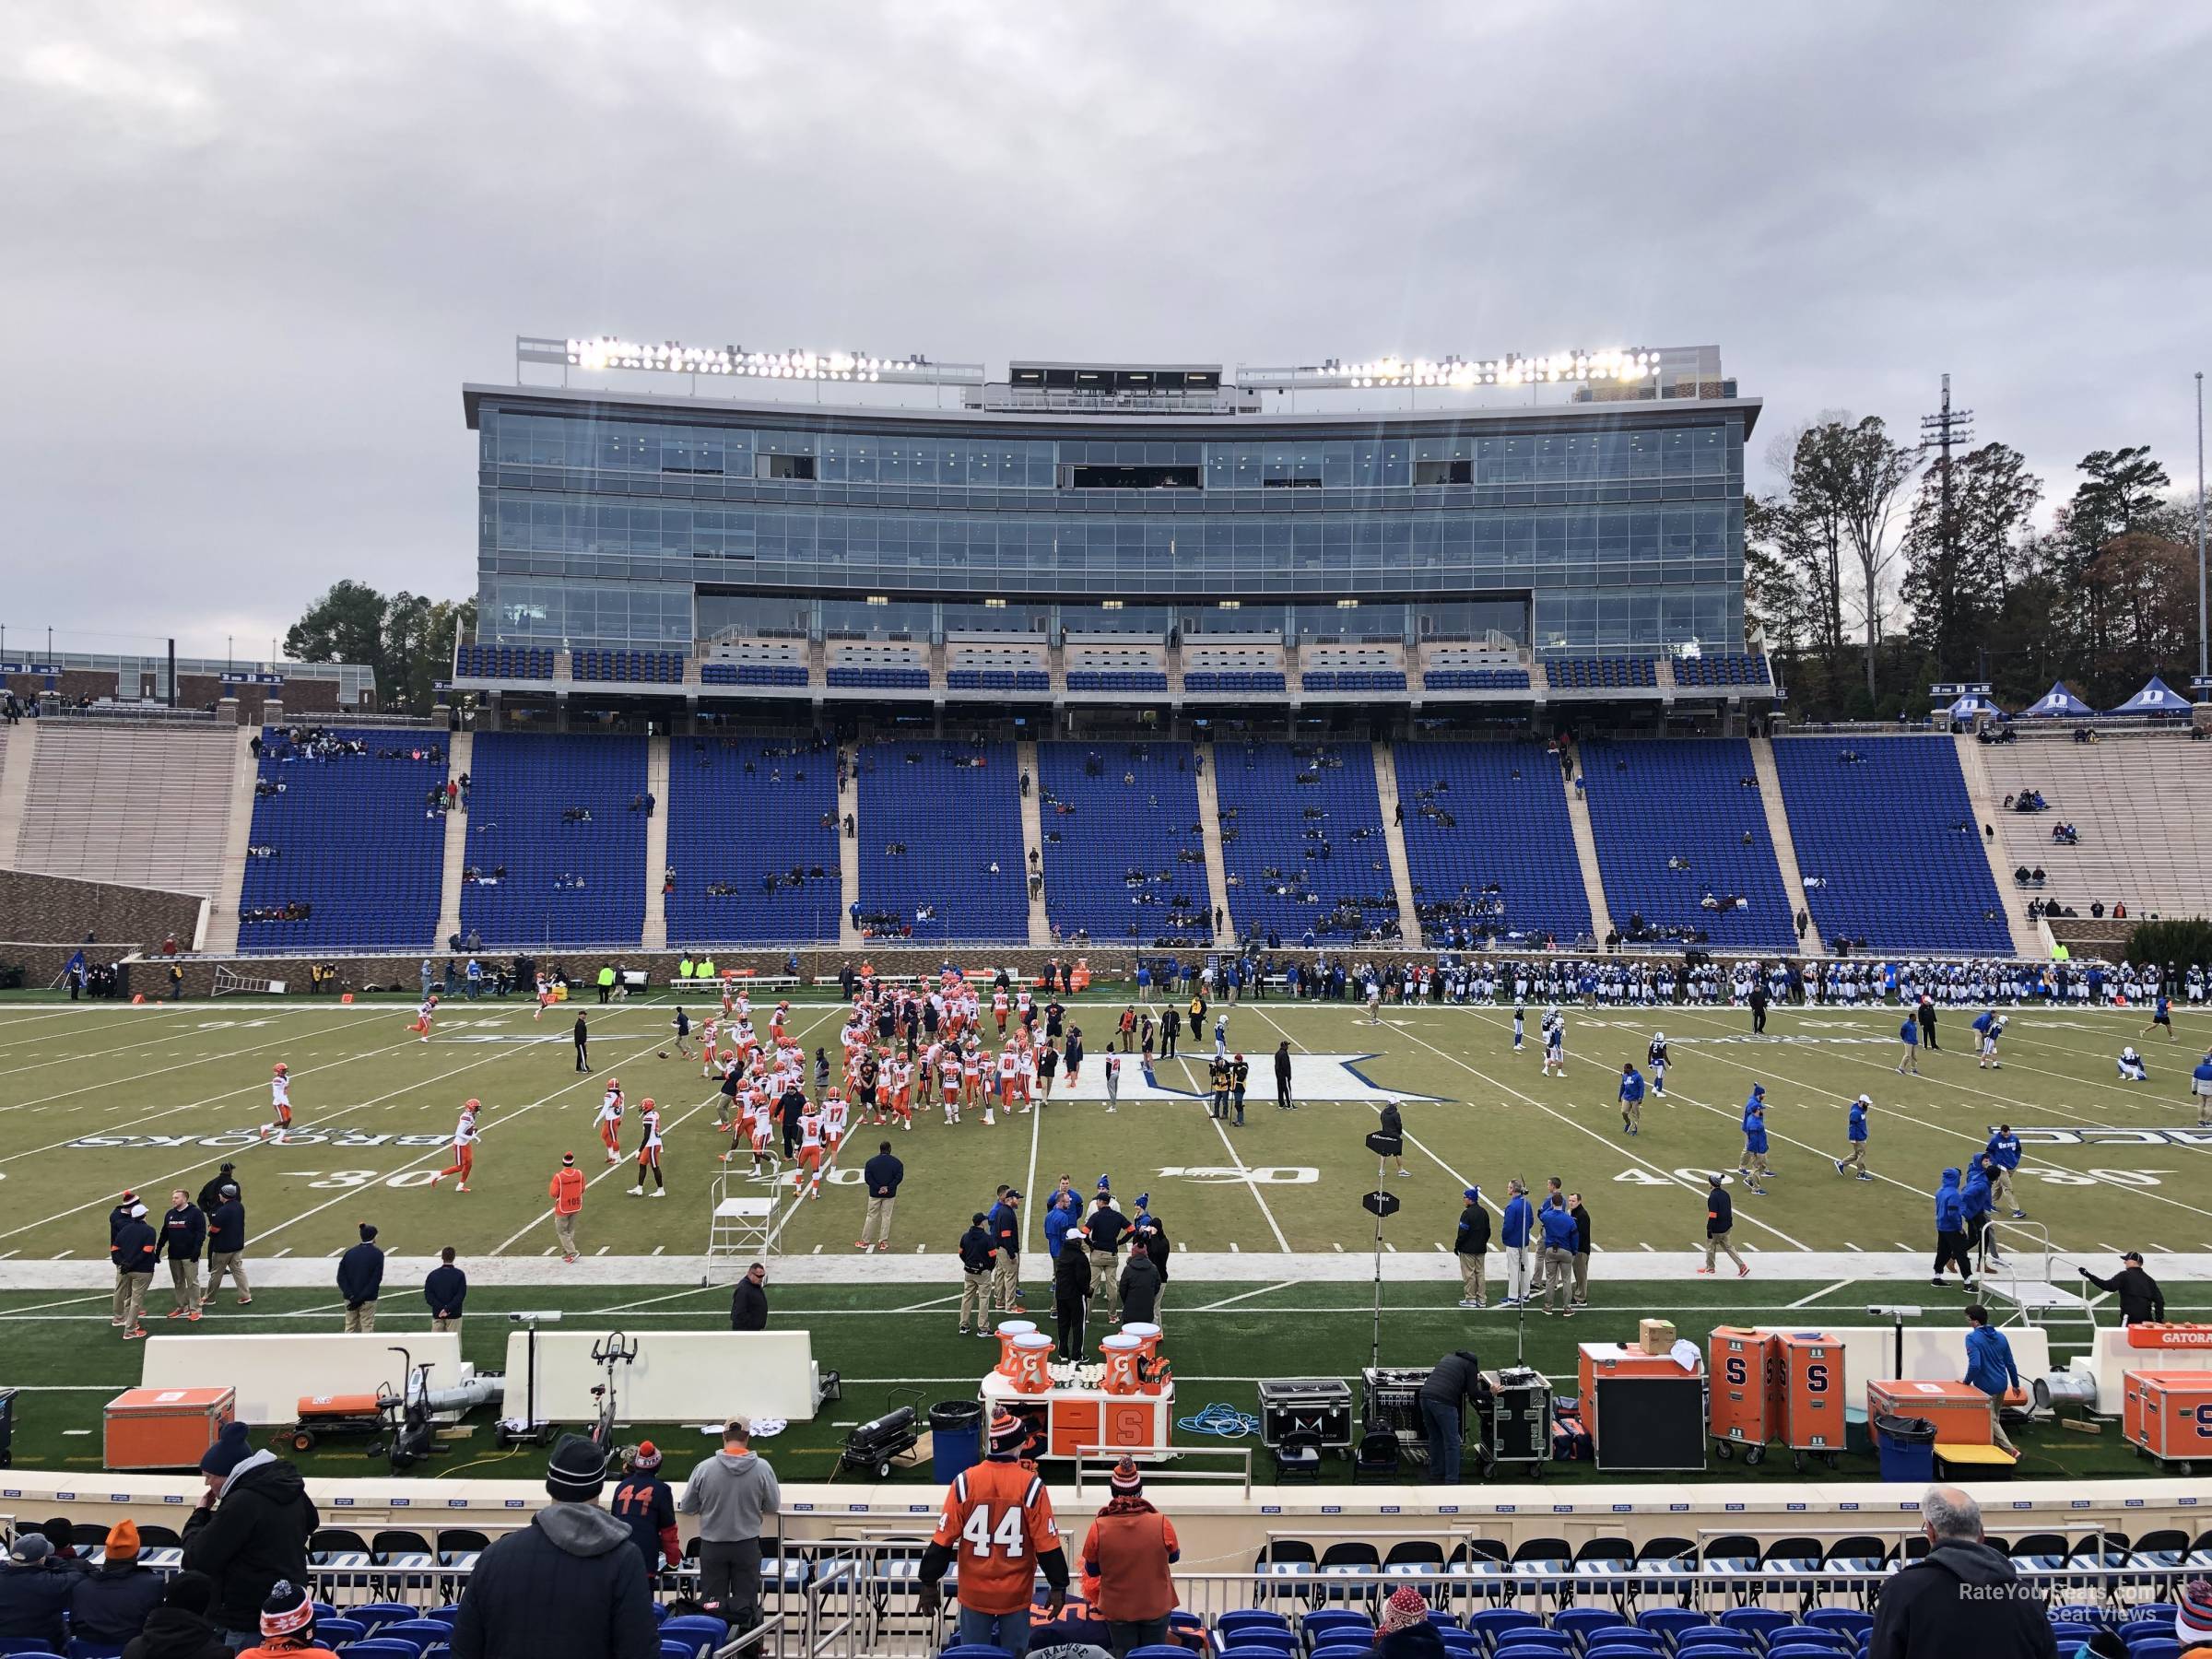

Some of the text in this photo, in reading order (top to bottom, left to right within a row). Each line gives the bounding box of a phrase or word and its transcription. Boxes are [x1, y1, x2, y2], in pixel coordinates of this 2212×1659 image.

[1653, 1043, 1658, 1053] 2
[1004, 1058, 1015, 1070] 81
[777, 1079, 786, 1093] 11
[830, 1108, 843, 1122] 17
[807, 1122, 818, 1136] 6
[65, 1133, 456, 1148] BROOKS
[308, 1170, 445, 1188] 30
[1612, 1167, 1740, 1185] 40
[2013, 1168, 2162, 1186] 30
[1372, 1194, 1391, 1202] Teex
[1022, 1354, 1038, 1371] G
[1113, 1355, 1129, 1372] G
[1725, 1356, 1747, 1386] S
[1806, 1364, 1829, 1394] S
[1116, 1409, 1144, 1446] S
[618, 1484, 655, 1517] 44
[962, 1504, 1025, 1558] 44
